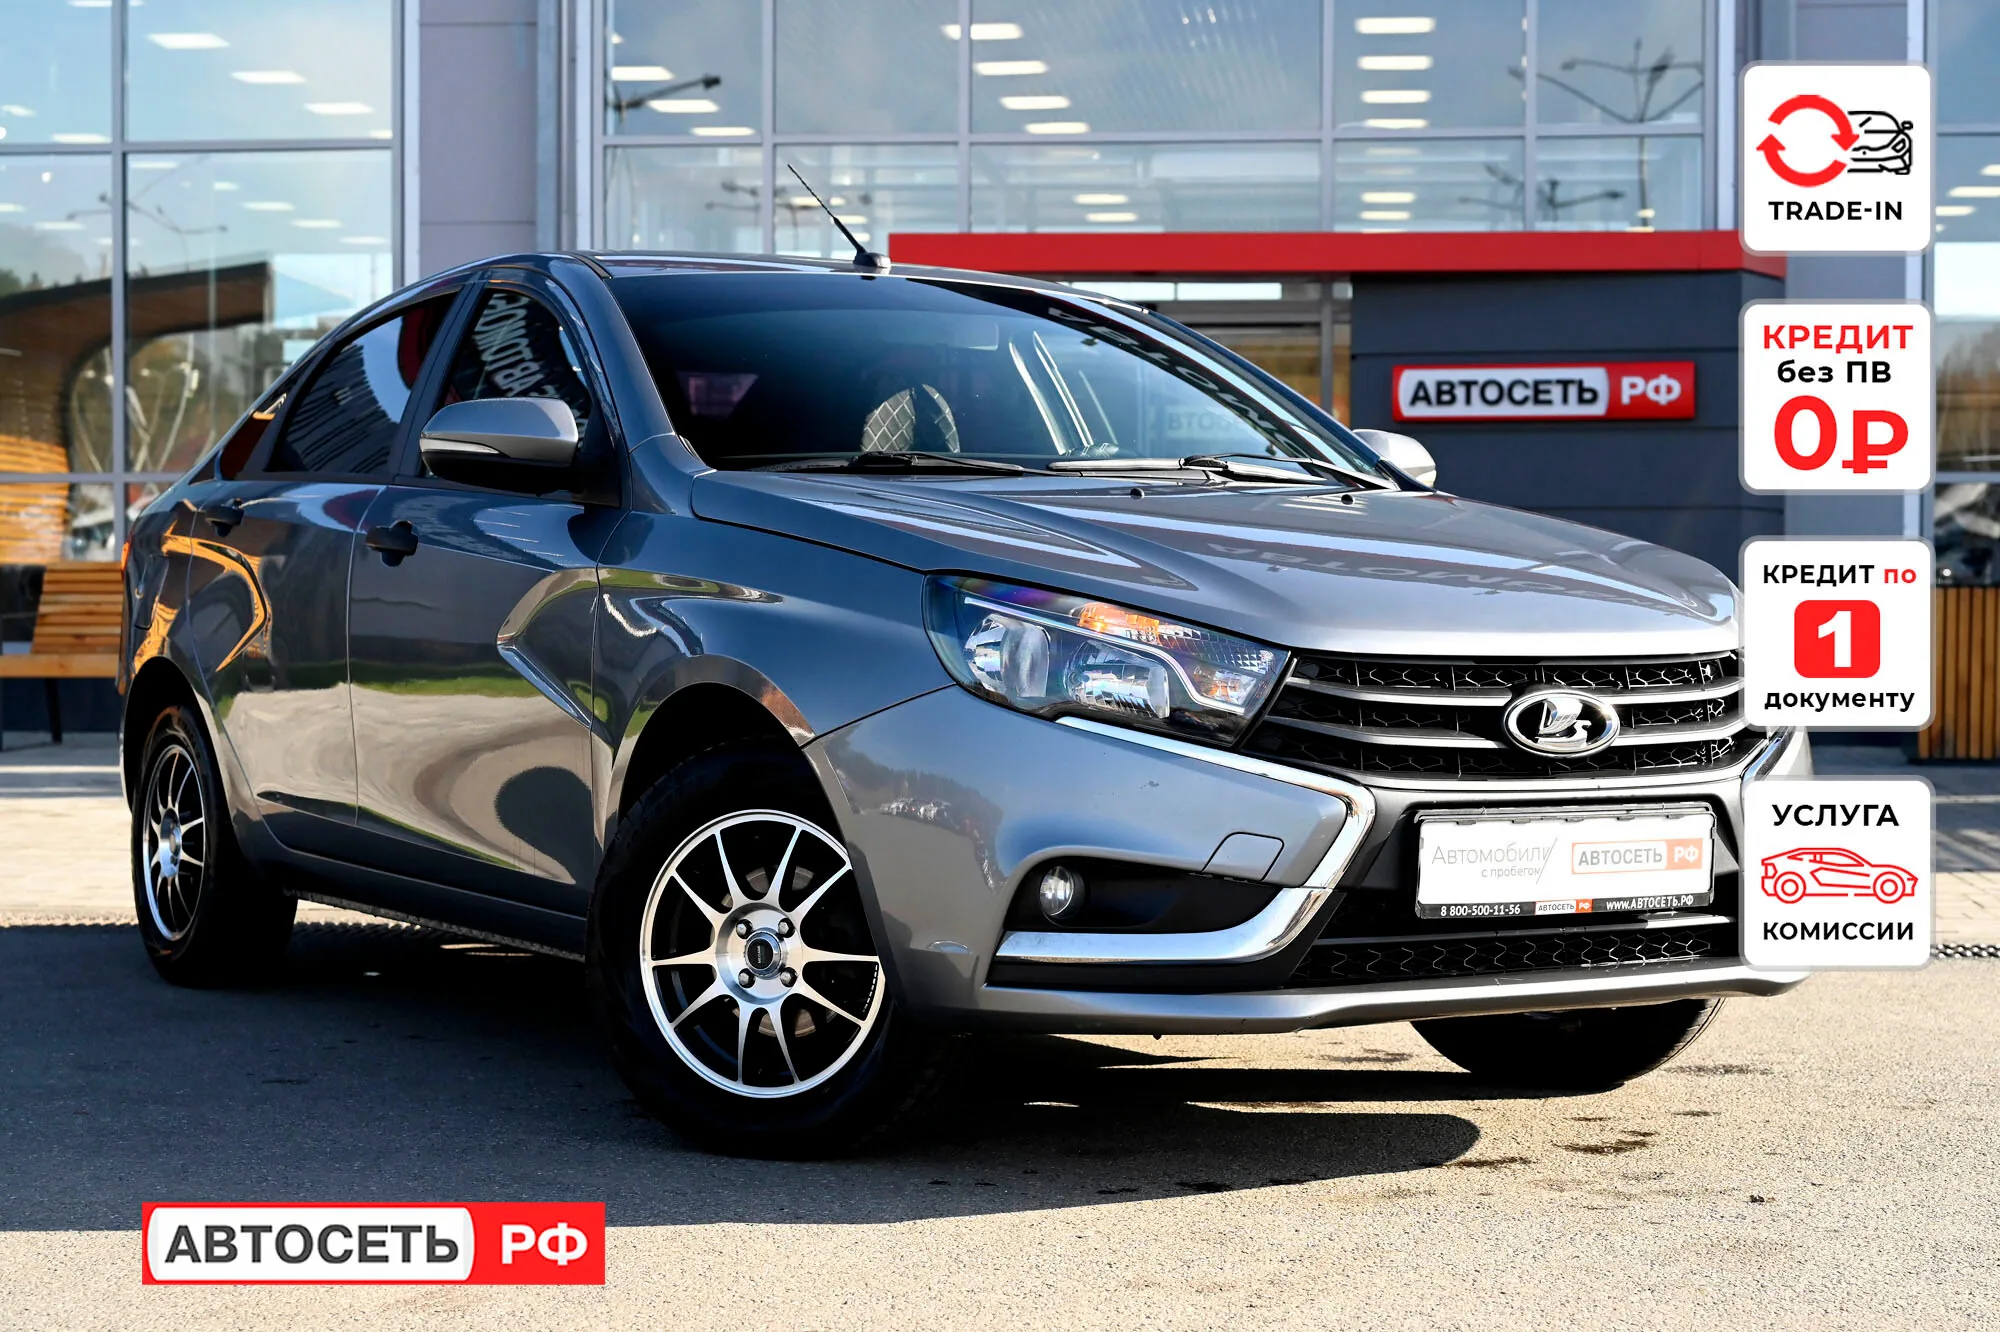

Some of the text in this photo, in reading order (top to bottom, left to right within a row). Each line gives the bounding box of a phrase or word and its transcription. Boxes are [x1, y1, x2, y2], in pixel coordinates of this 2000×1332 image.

[1408, 374, 1682, 407] АВТОСЕТЬ РФ
[1578, 845, 1699, 866] АВТОСЕТЬ РФ
[1481, 869, 1489, 878] с
[1440, 904, 1521, 917] 8 800-500-11-56
[1538, 901, 1591, 912] АВТОСЕТЬ РФ
